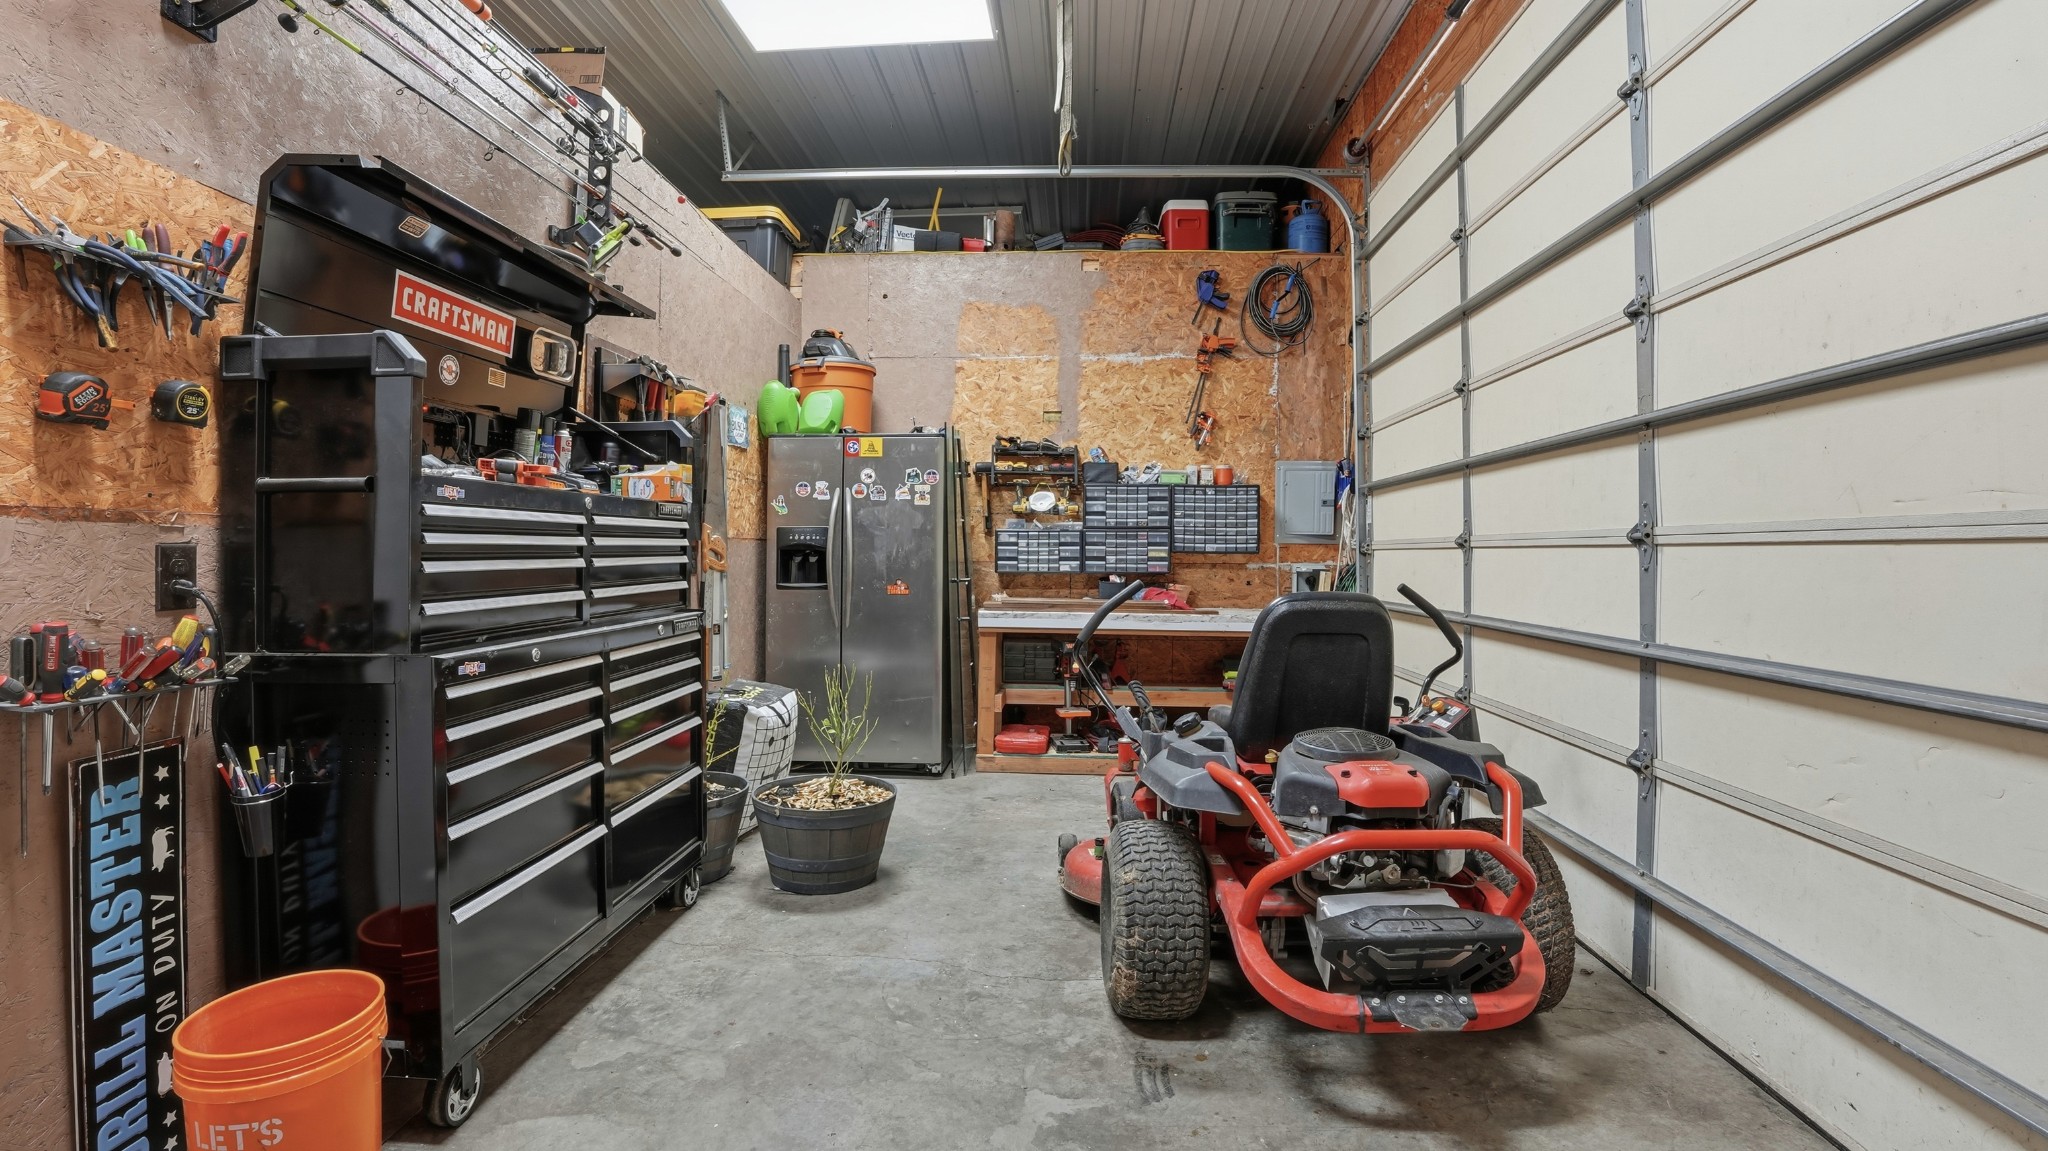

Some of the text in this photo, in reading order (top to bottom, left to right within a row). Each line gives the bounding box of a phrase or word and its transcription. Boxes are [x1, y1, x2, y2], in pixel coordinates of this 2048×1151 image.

[402, 286, 509, 346] CRAFTSMAN
[74, 386, 95, 403] KLEIN
[77, 390, 98, 406] TOOLS
[89, 776, 150, 1151] RILL MASTER
[150, 895, 178, 1033] ON DUTY
[194, 1118, 284, 1151] LET'S
